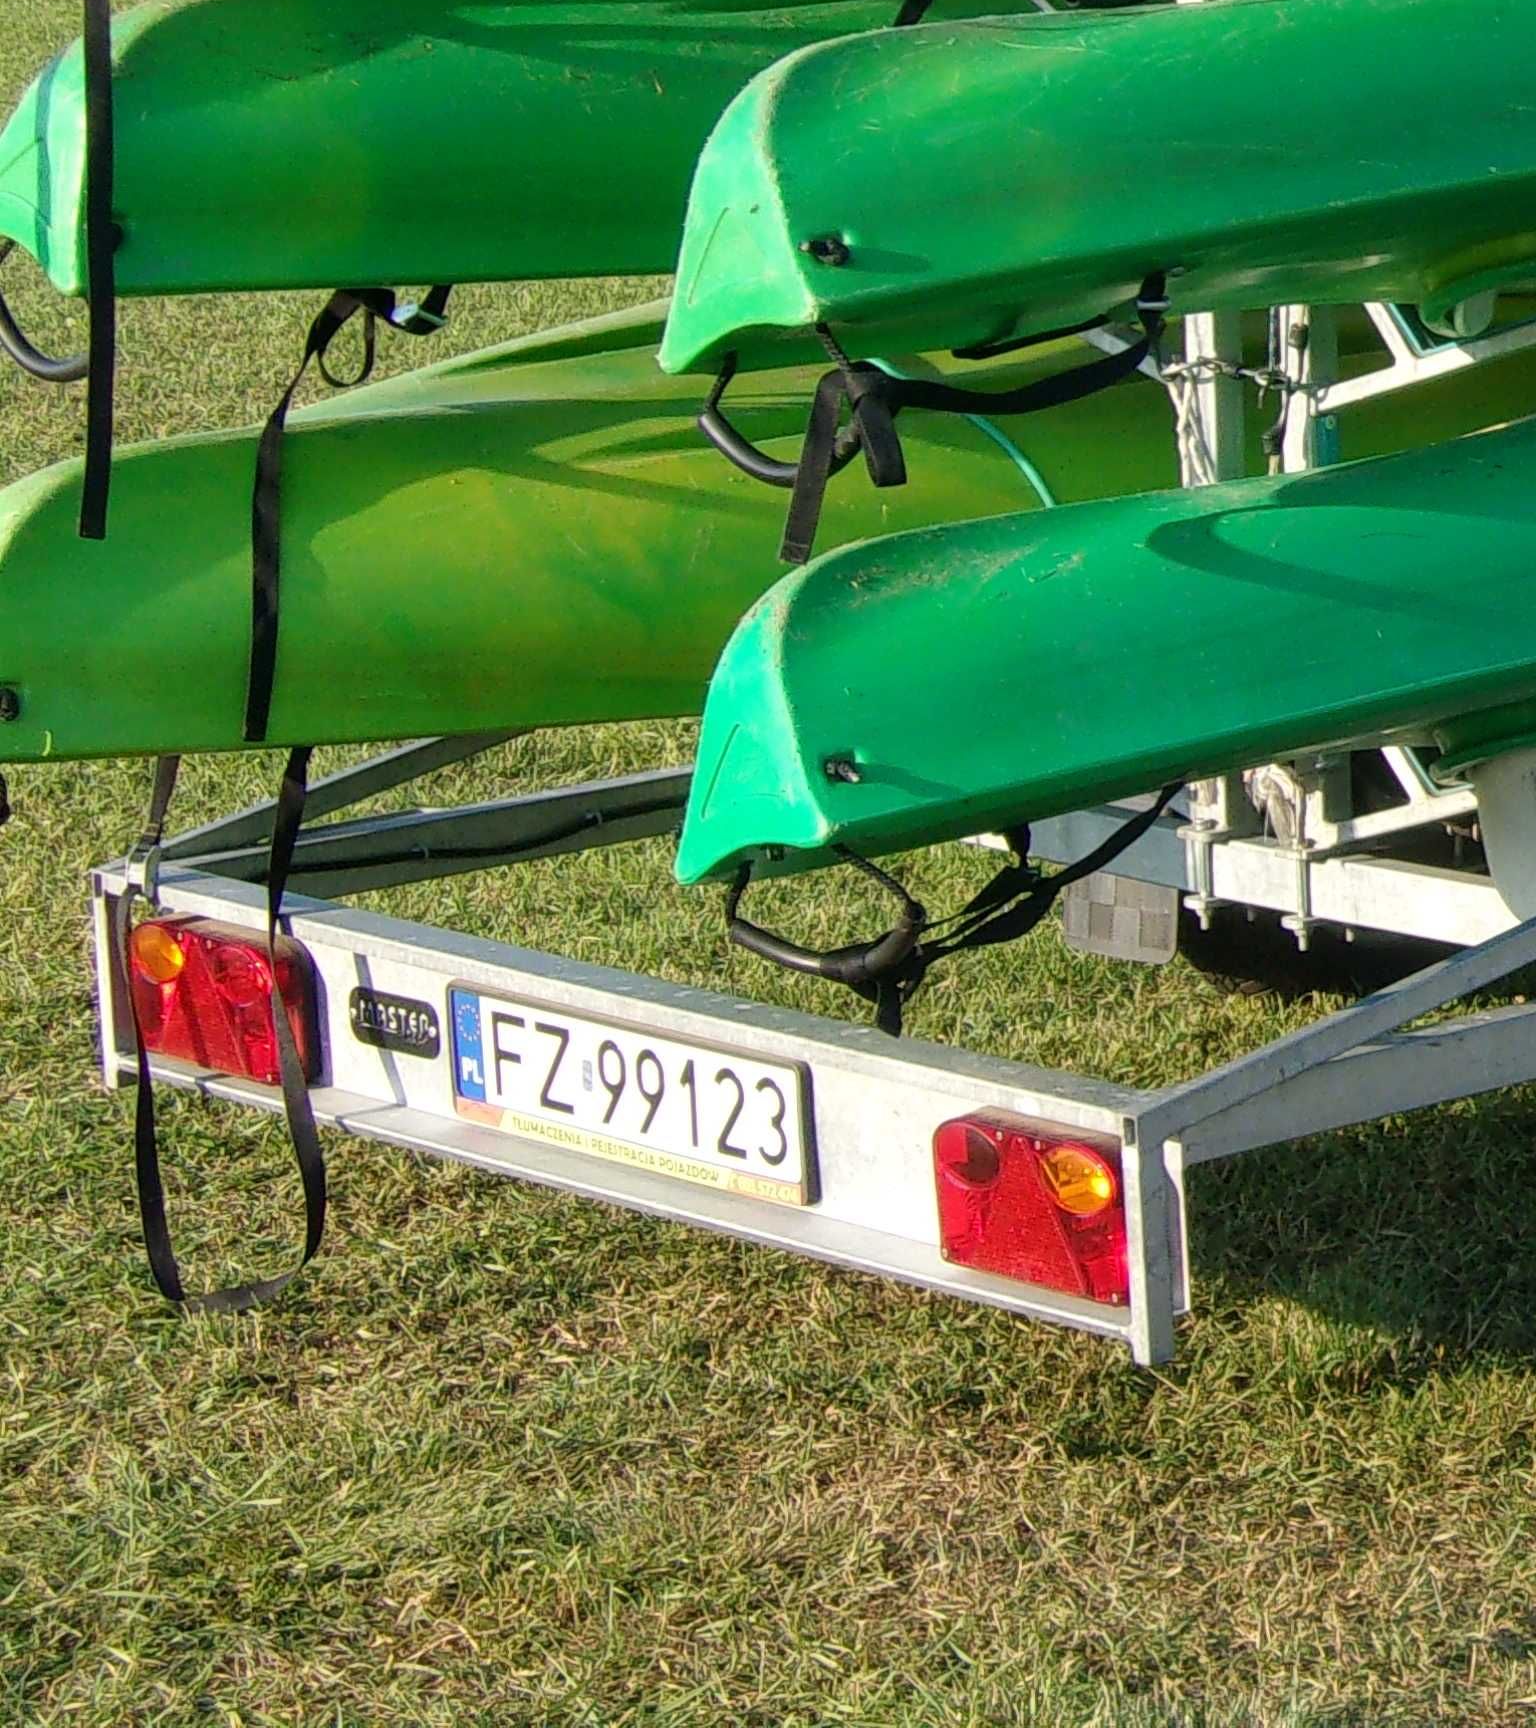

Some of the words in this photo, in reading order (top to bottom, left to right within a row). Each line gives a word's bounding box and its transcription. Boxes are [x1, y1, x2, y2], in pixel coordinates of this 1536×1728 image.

[461, 1056, 484, 1085] PL
[491, 1011, 575, 1114] FZ
[597, 1040, 788, 1167] 99123
